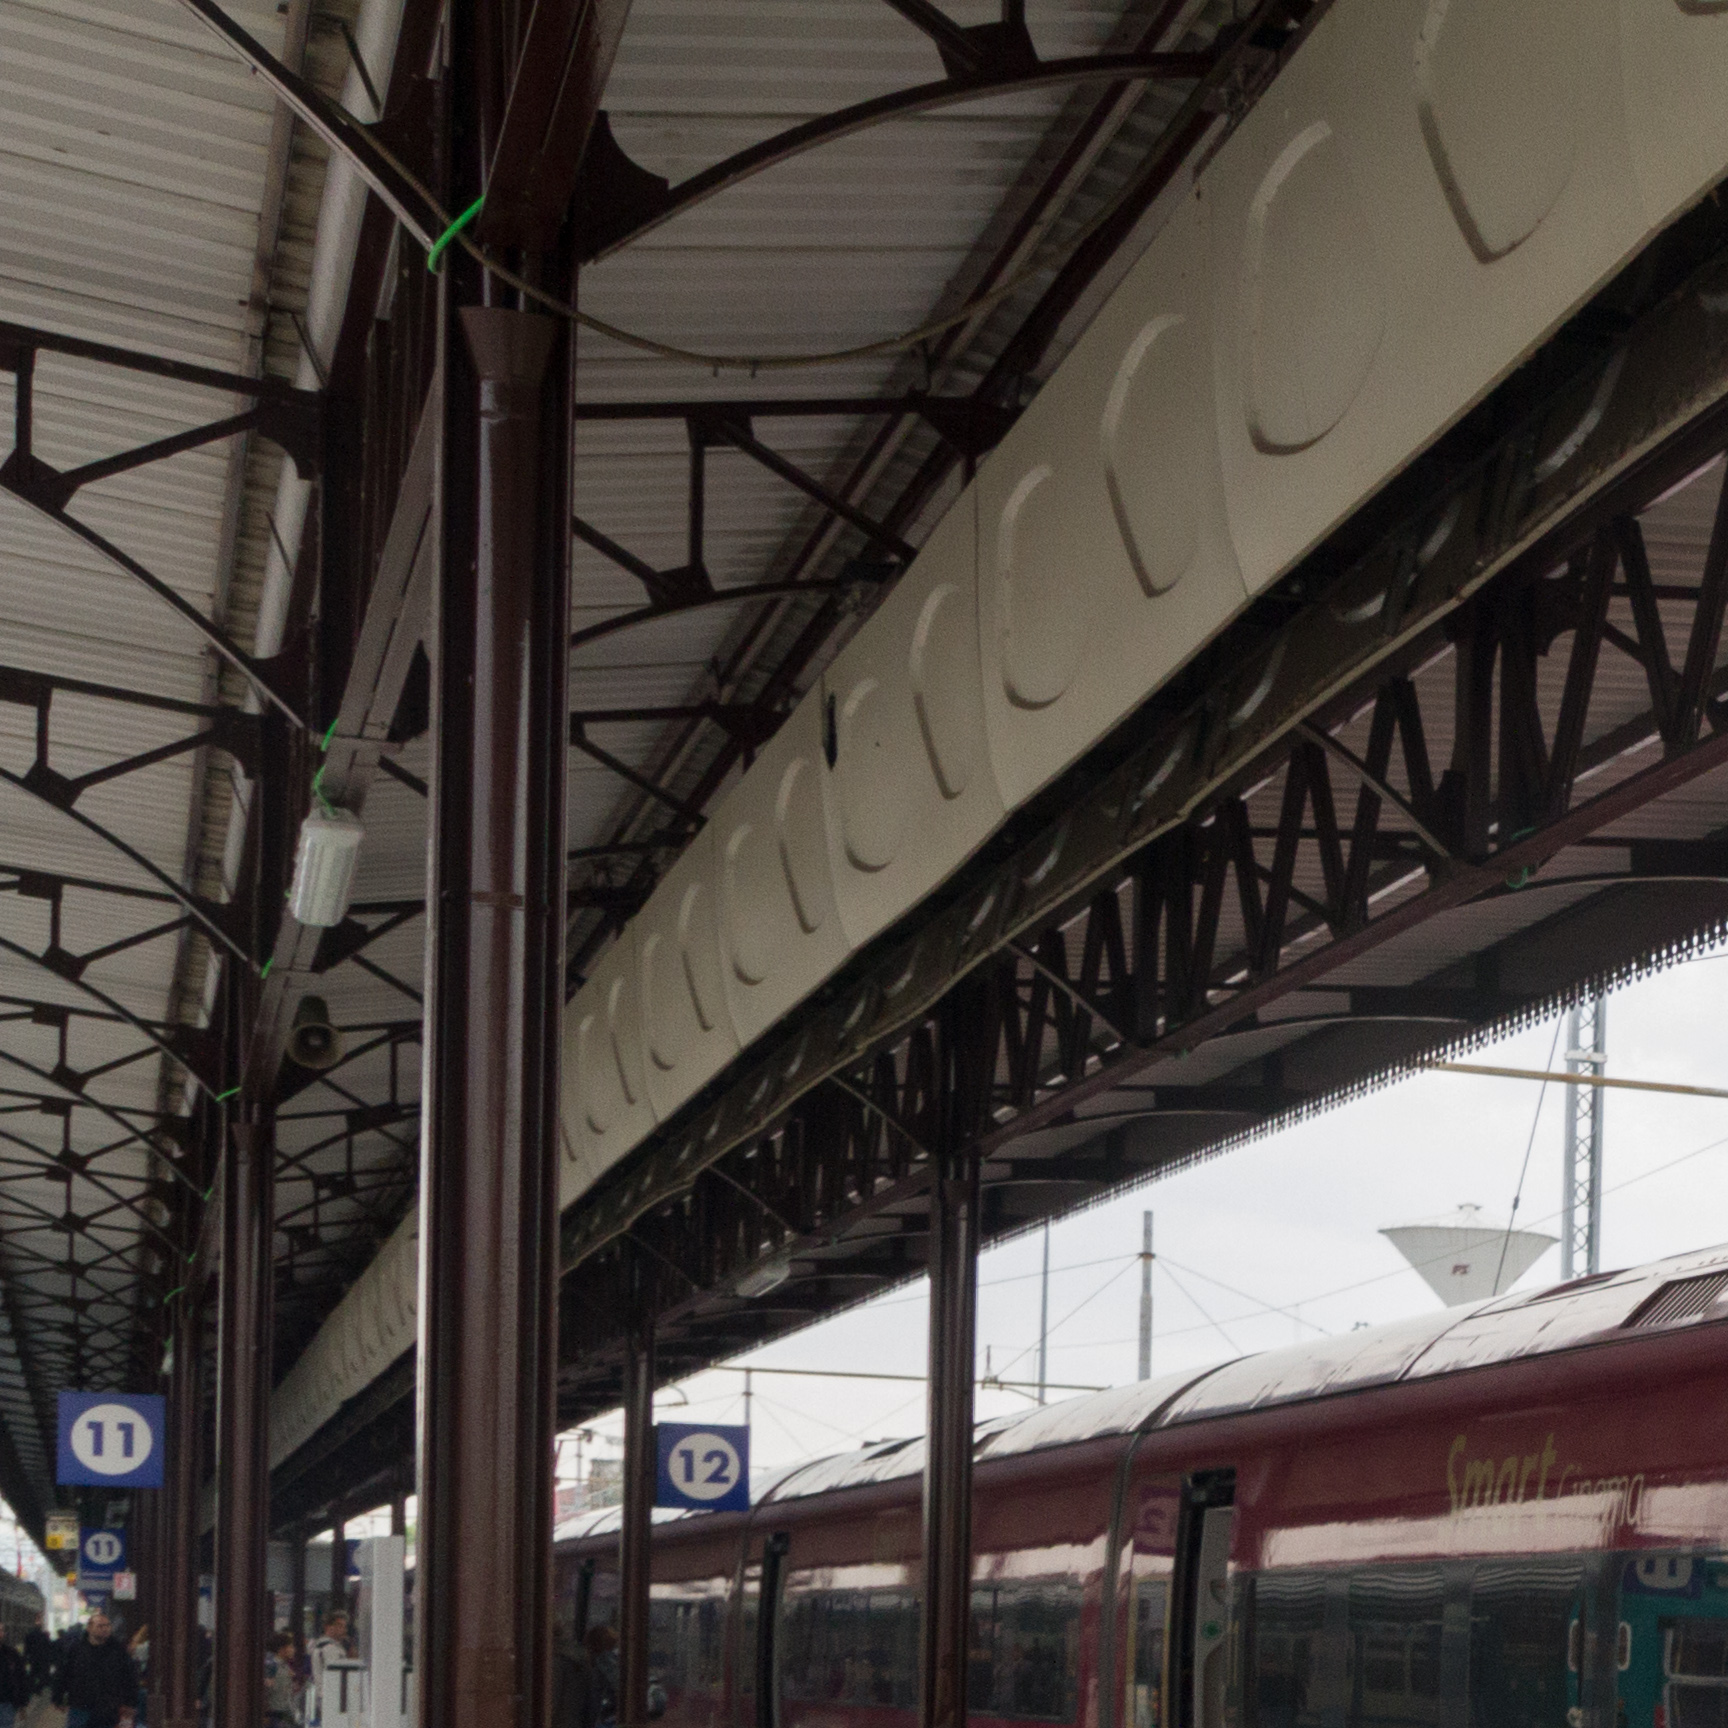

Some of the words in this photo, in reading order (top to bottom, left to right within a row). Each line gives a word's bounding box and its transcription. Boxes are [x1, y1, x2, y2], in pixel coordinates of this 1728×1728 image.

[86, 1420, 134, 1459] 11
[678, 1448, 731, 1484] 12
[92, 1539, 115, 1557] 11
